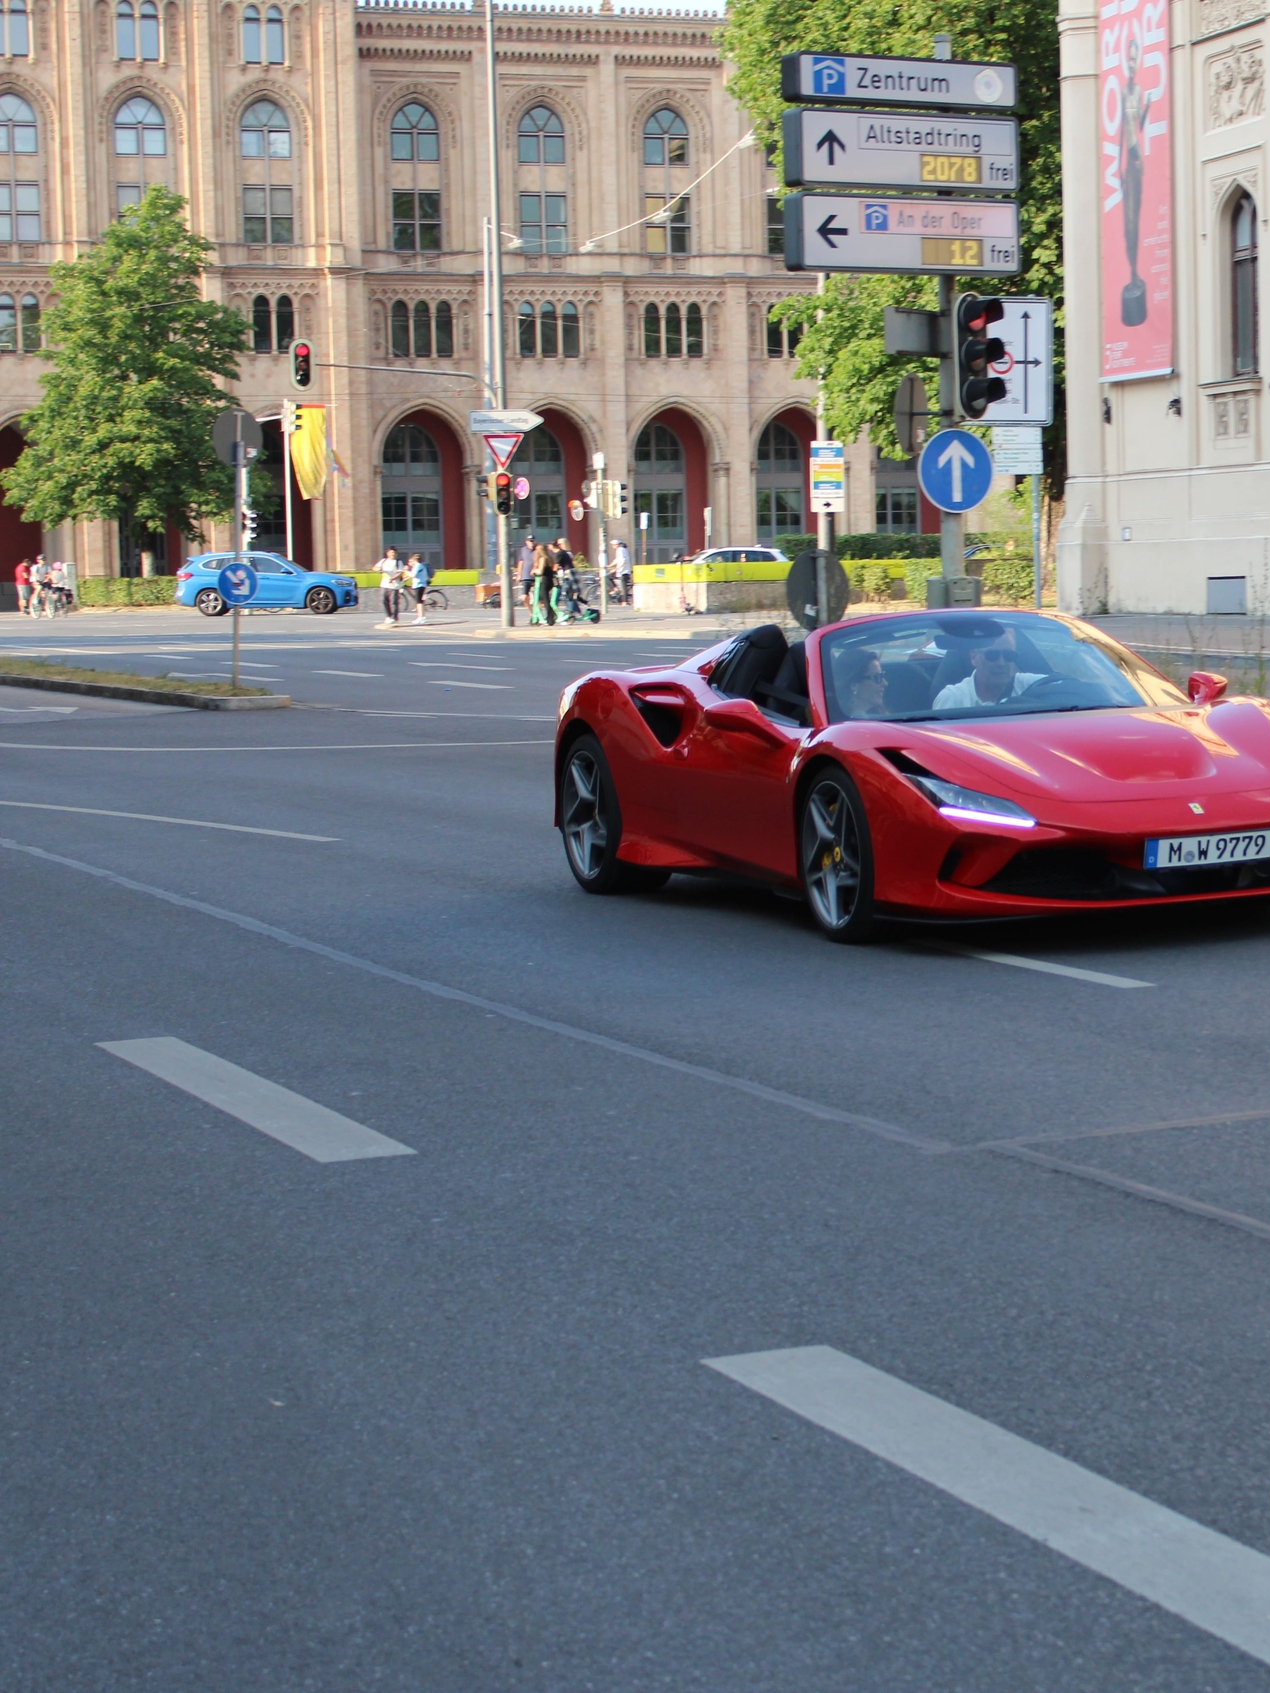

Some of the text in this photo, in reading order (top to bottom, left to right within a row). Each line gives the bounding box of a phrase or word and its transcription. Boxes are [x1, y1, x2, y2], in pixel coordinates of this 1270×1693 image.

[856, 67, 950, 94] Zentrum
[865, 124, 982, 153] Altstadtring
[922, 156, 1014, 182] 2078 frei
[897, 211, 915, 228] An
[921, 211, 944, 229] der
[951, 213, 983, 232] Oper
[951, 240, 1016, 265] 12 frei
[1168, 841, 1183, 863] M
[1197, 839, 1211, 861] W
[1216, 834, 1267, 859] 9779
